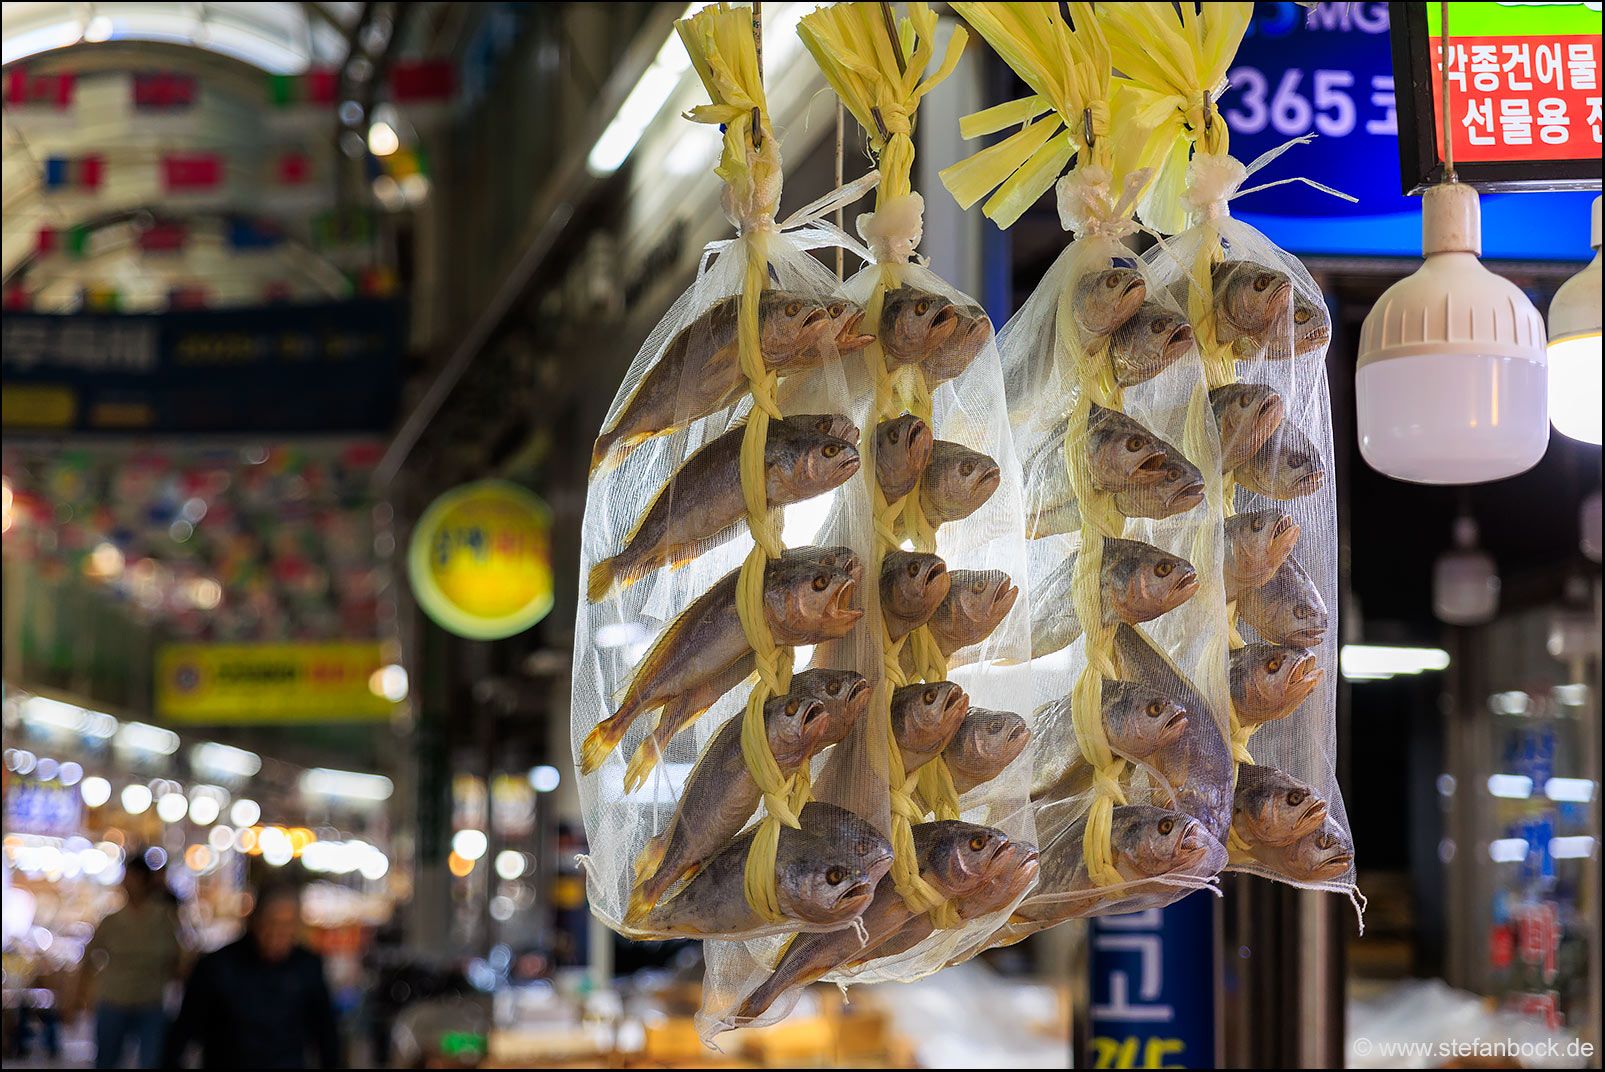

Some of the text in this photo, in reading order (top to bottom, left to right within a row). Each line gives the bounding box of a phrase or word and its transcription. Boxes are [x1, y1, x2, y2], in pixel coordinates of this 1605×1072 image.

[1438, 43, 1597, 92] 각종건어물
[1226, 66, 1357, 137] 365
[1462, 98, 1570, 145] 선물용
